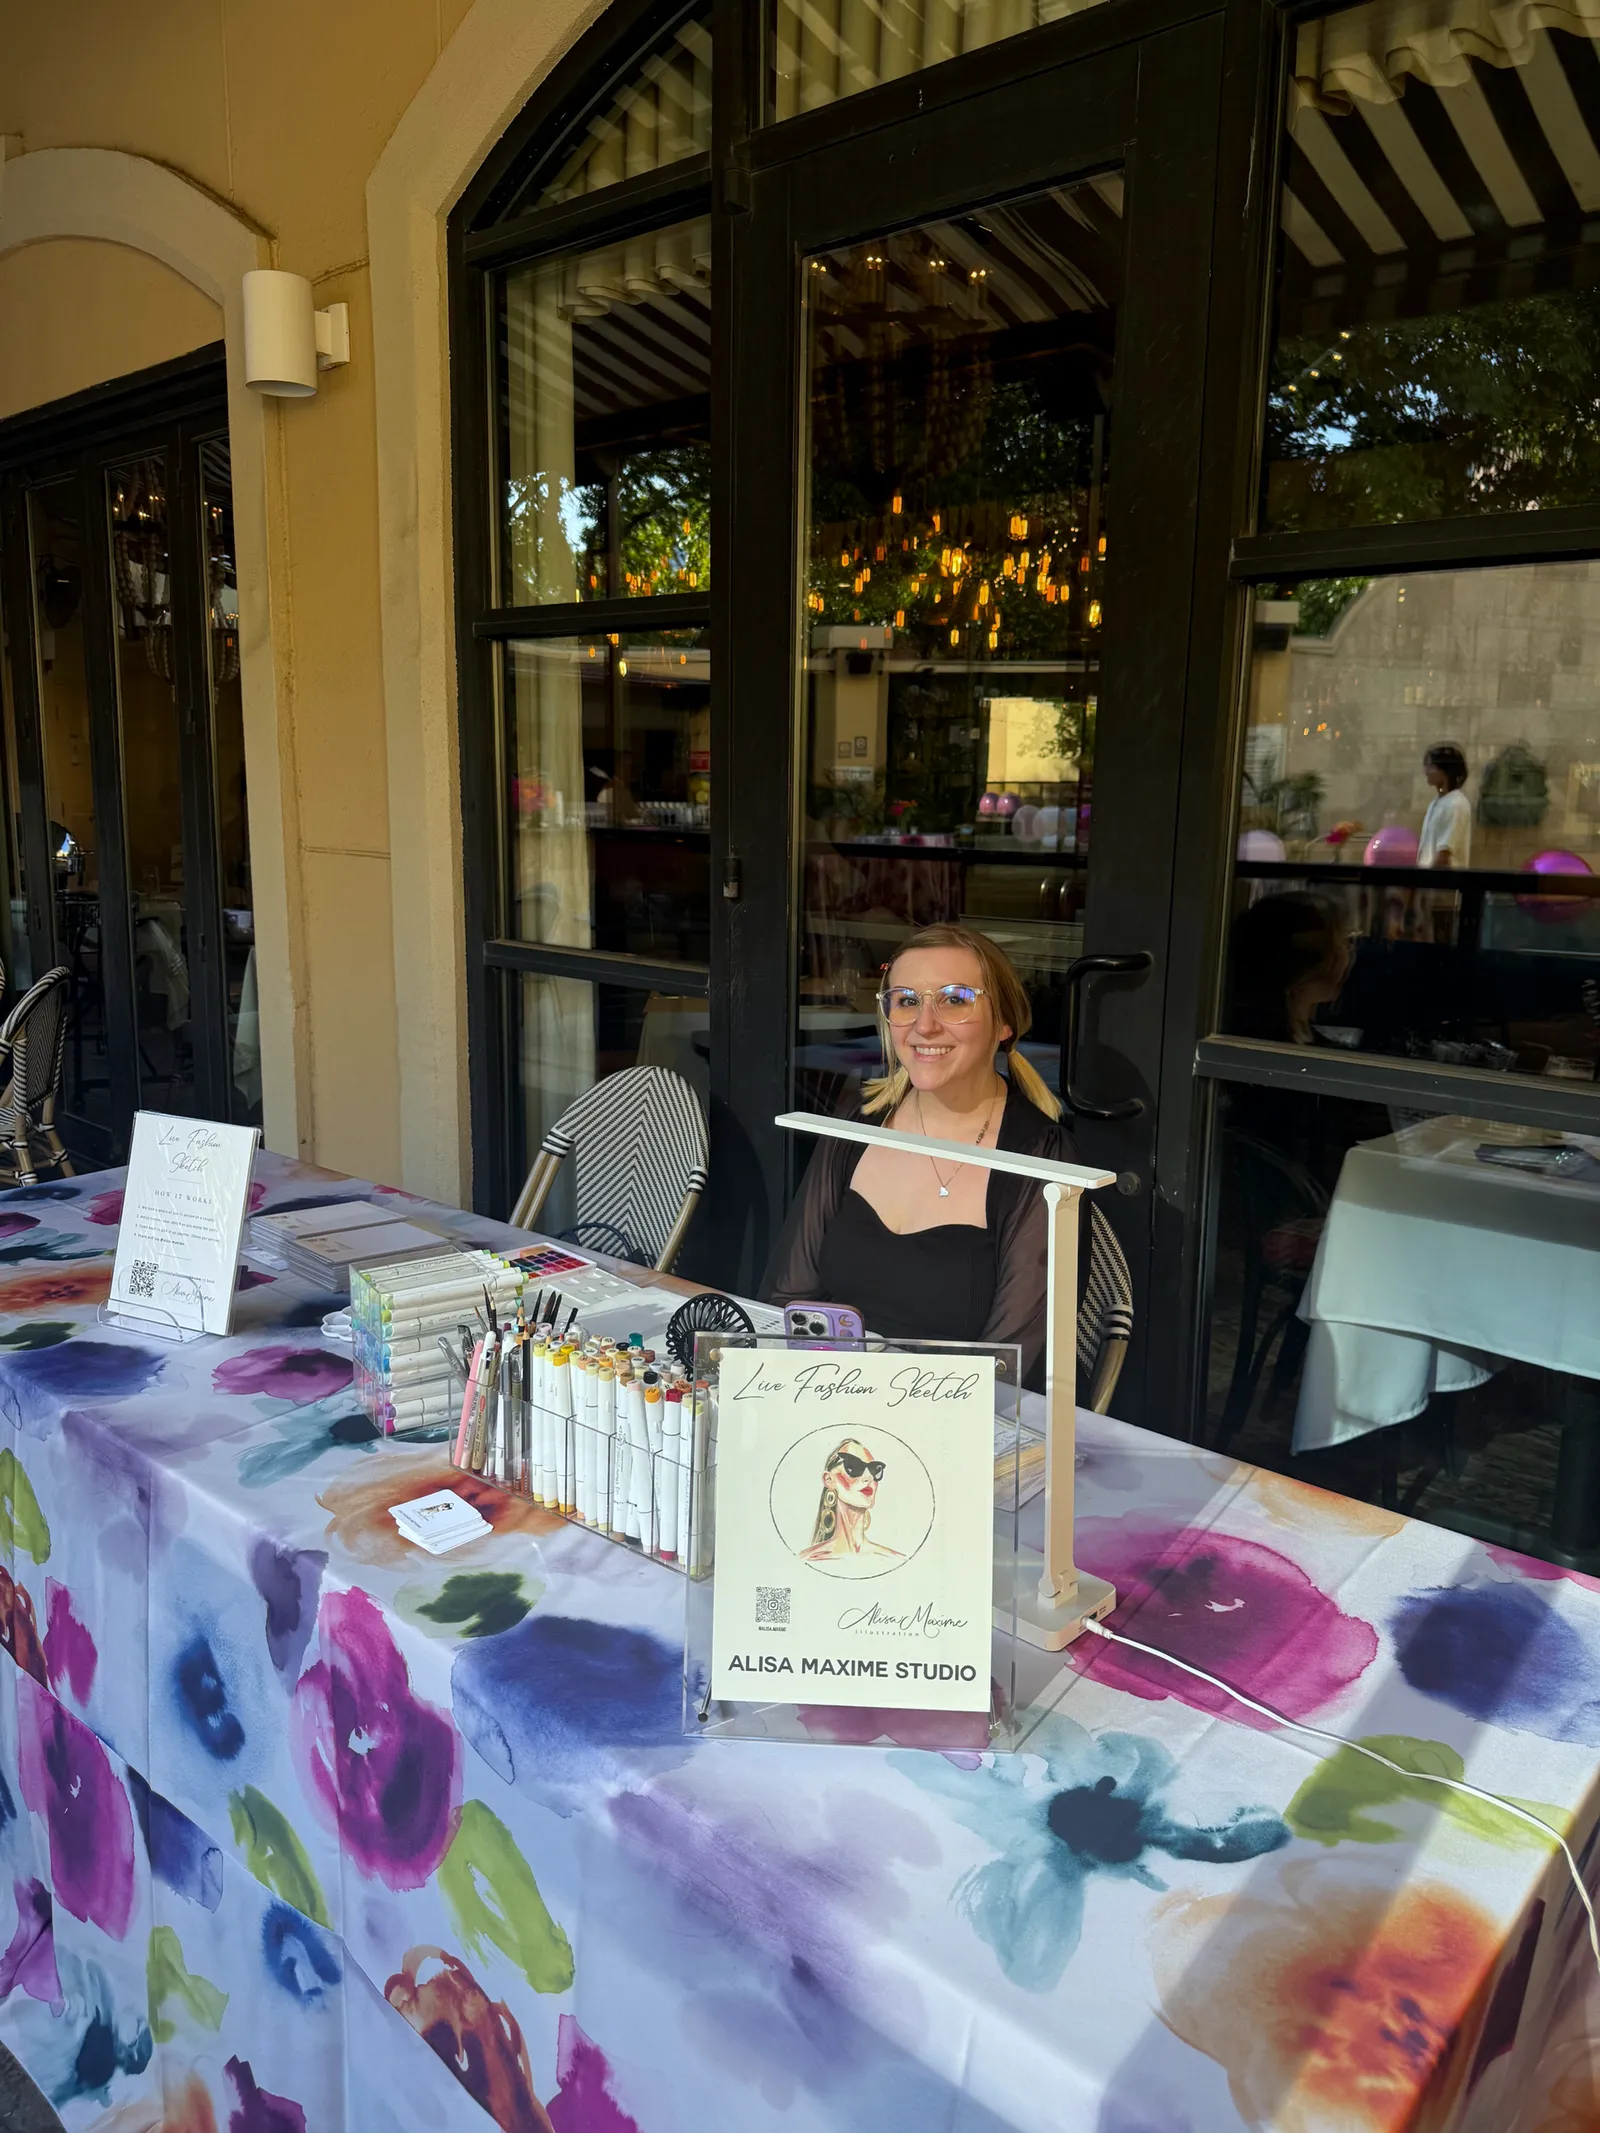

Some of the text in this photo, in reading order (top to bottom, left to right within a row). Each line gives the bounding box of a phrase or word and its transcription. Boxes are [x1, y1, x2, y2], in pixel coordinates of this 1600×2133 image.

[186, 1128, 221, 1150] Fashion
[170, 1152, 209, 1173] Sketch
[154, 1189, 172, 1197] HOW
[733, 1362, 786, 1401] Live
[793, 1364, 879, 1404] Fashion
[886, 1366, 981, 1408] Sketch
[837, 1601, 968, 1639] Alisa Maxime
[728, 1654, 977, 1682] ALISA MAXIME STUDIO
